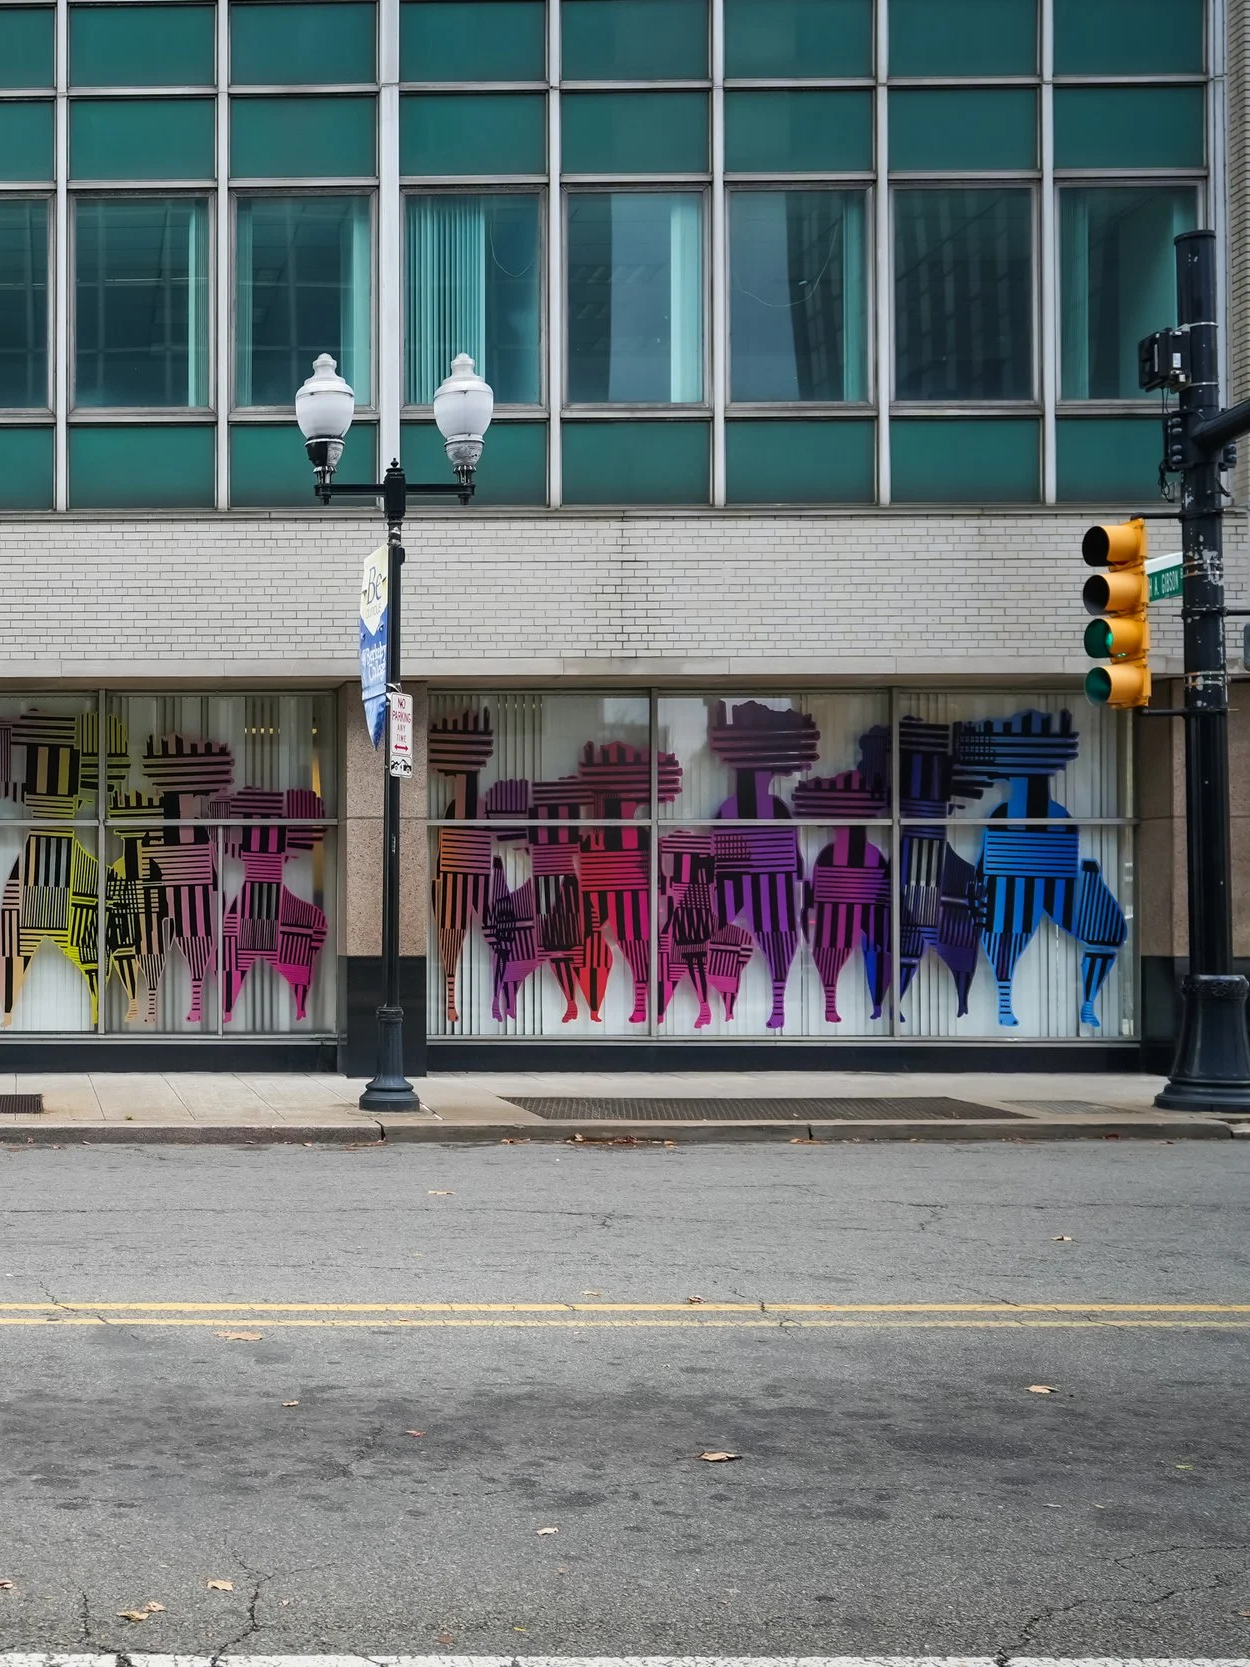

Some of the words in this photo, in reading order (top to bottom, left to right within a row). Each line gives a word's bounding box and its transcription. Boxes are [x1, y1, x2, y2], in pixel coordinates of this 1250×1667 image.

[367, 566, 383, 604] Be
[1161, 570, 1179, 594] GIBSON
[397, 697, 406, 709] NO
[391, 710, 411, 723] PARKING
[397, 723, 406, 732] ANY
[396, 733, 407, 743] TIME
